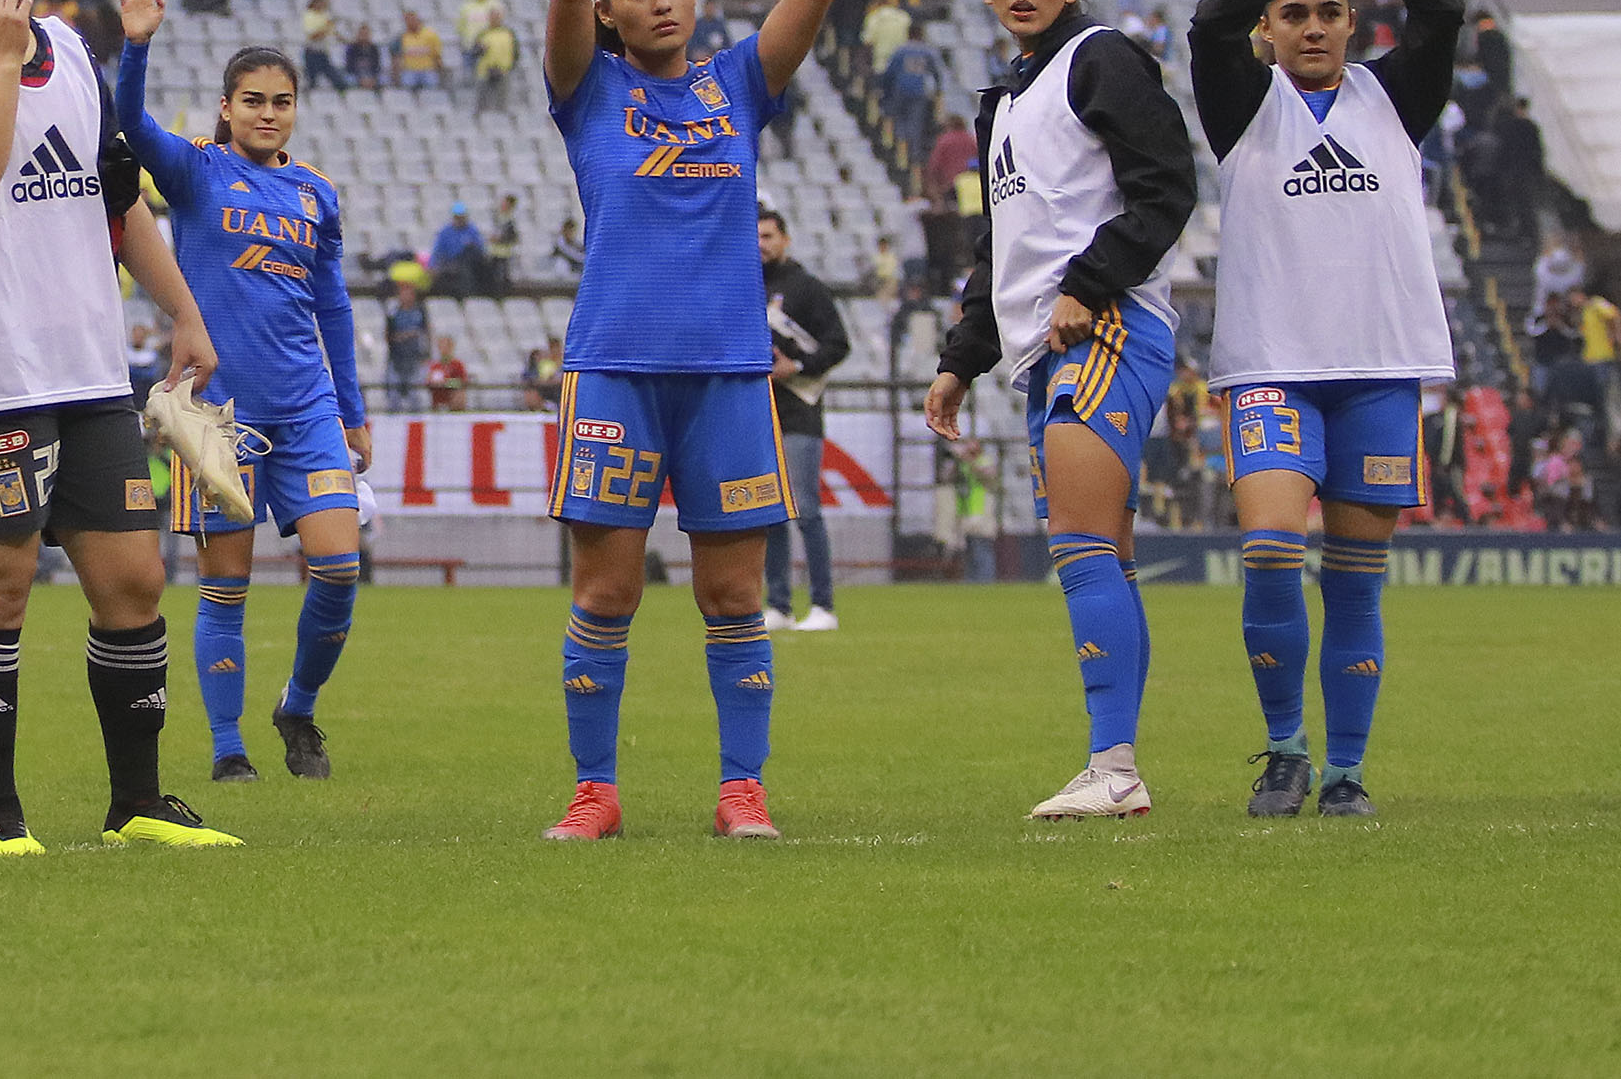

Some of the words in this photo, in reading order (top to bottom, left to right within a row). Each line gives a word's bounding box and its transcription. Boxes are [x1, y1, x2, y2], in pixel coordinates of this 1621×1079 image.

[671, 162, 742, 178] CEMEX
[1283, 168, 1380, 196] adidas
[11, 172, 101, 203] adidas
[1273, 406, 1302, 456] 3
[597, 445, 662, 507] 22
